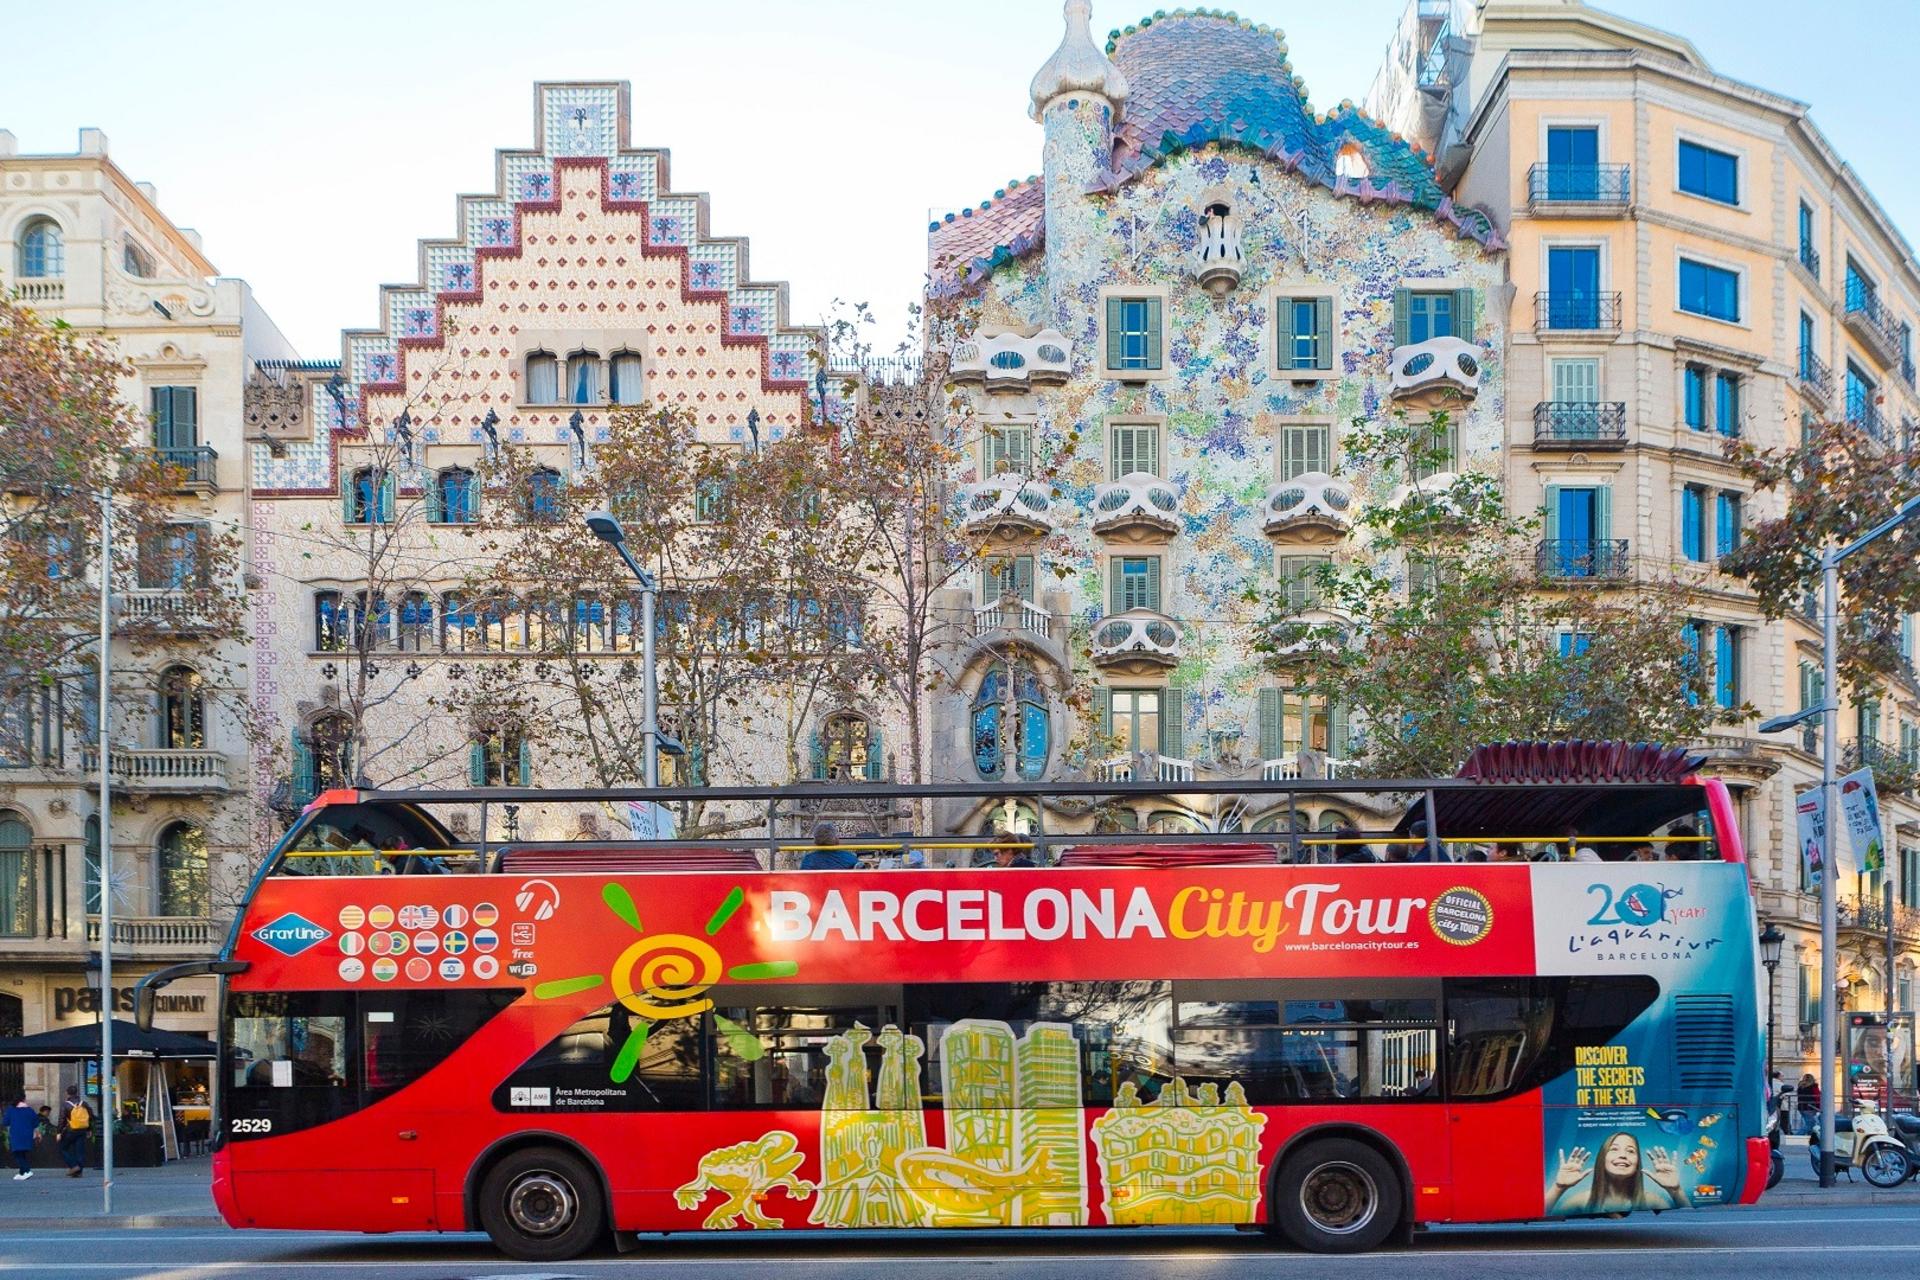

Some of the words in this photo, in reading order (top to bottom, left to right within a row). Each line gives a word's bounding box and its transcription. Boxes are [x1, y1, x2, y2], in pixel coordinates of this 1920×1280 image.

[1445, 895, 1481, 910] OFFICIAL
[769, 887, 1167, 942] BARCELONA
[1168, 886, 1290, 954] City
[1284, 884, 1427, 937] Tour
[1437, 905, 1487, 922] BARCELONA
[1437, 919, 1460, 933] city
[1459, 922, 1480, 934] TOUR
[1285, 941, 1420, 952] www.barcelonacitytour.es
[1597, 952, 1692, 961] BARCELONA
[155, 995, 206, 1012] COMPANY
[1575, 1046, 1628, 1066] DISCOVER
[1576, 1067, 1598, 1086] THE
[1598, 1066, 1645, 1086] SECRETS
[574, 1088, 627, 1098] Metropolitana
[1577, 1088, 1591, 1107] OF
[1592, 1088, 1614, 1106] THE
[1614, 1087, 1637, 1106] SEA
[555, 1098, 566, 1106] de
[567, 1098, 605, 1106] Barcelona
[231, 1118, 272, 1133] 2529
